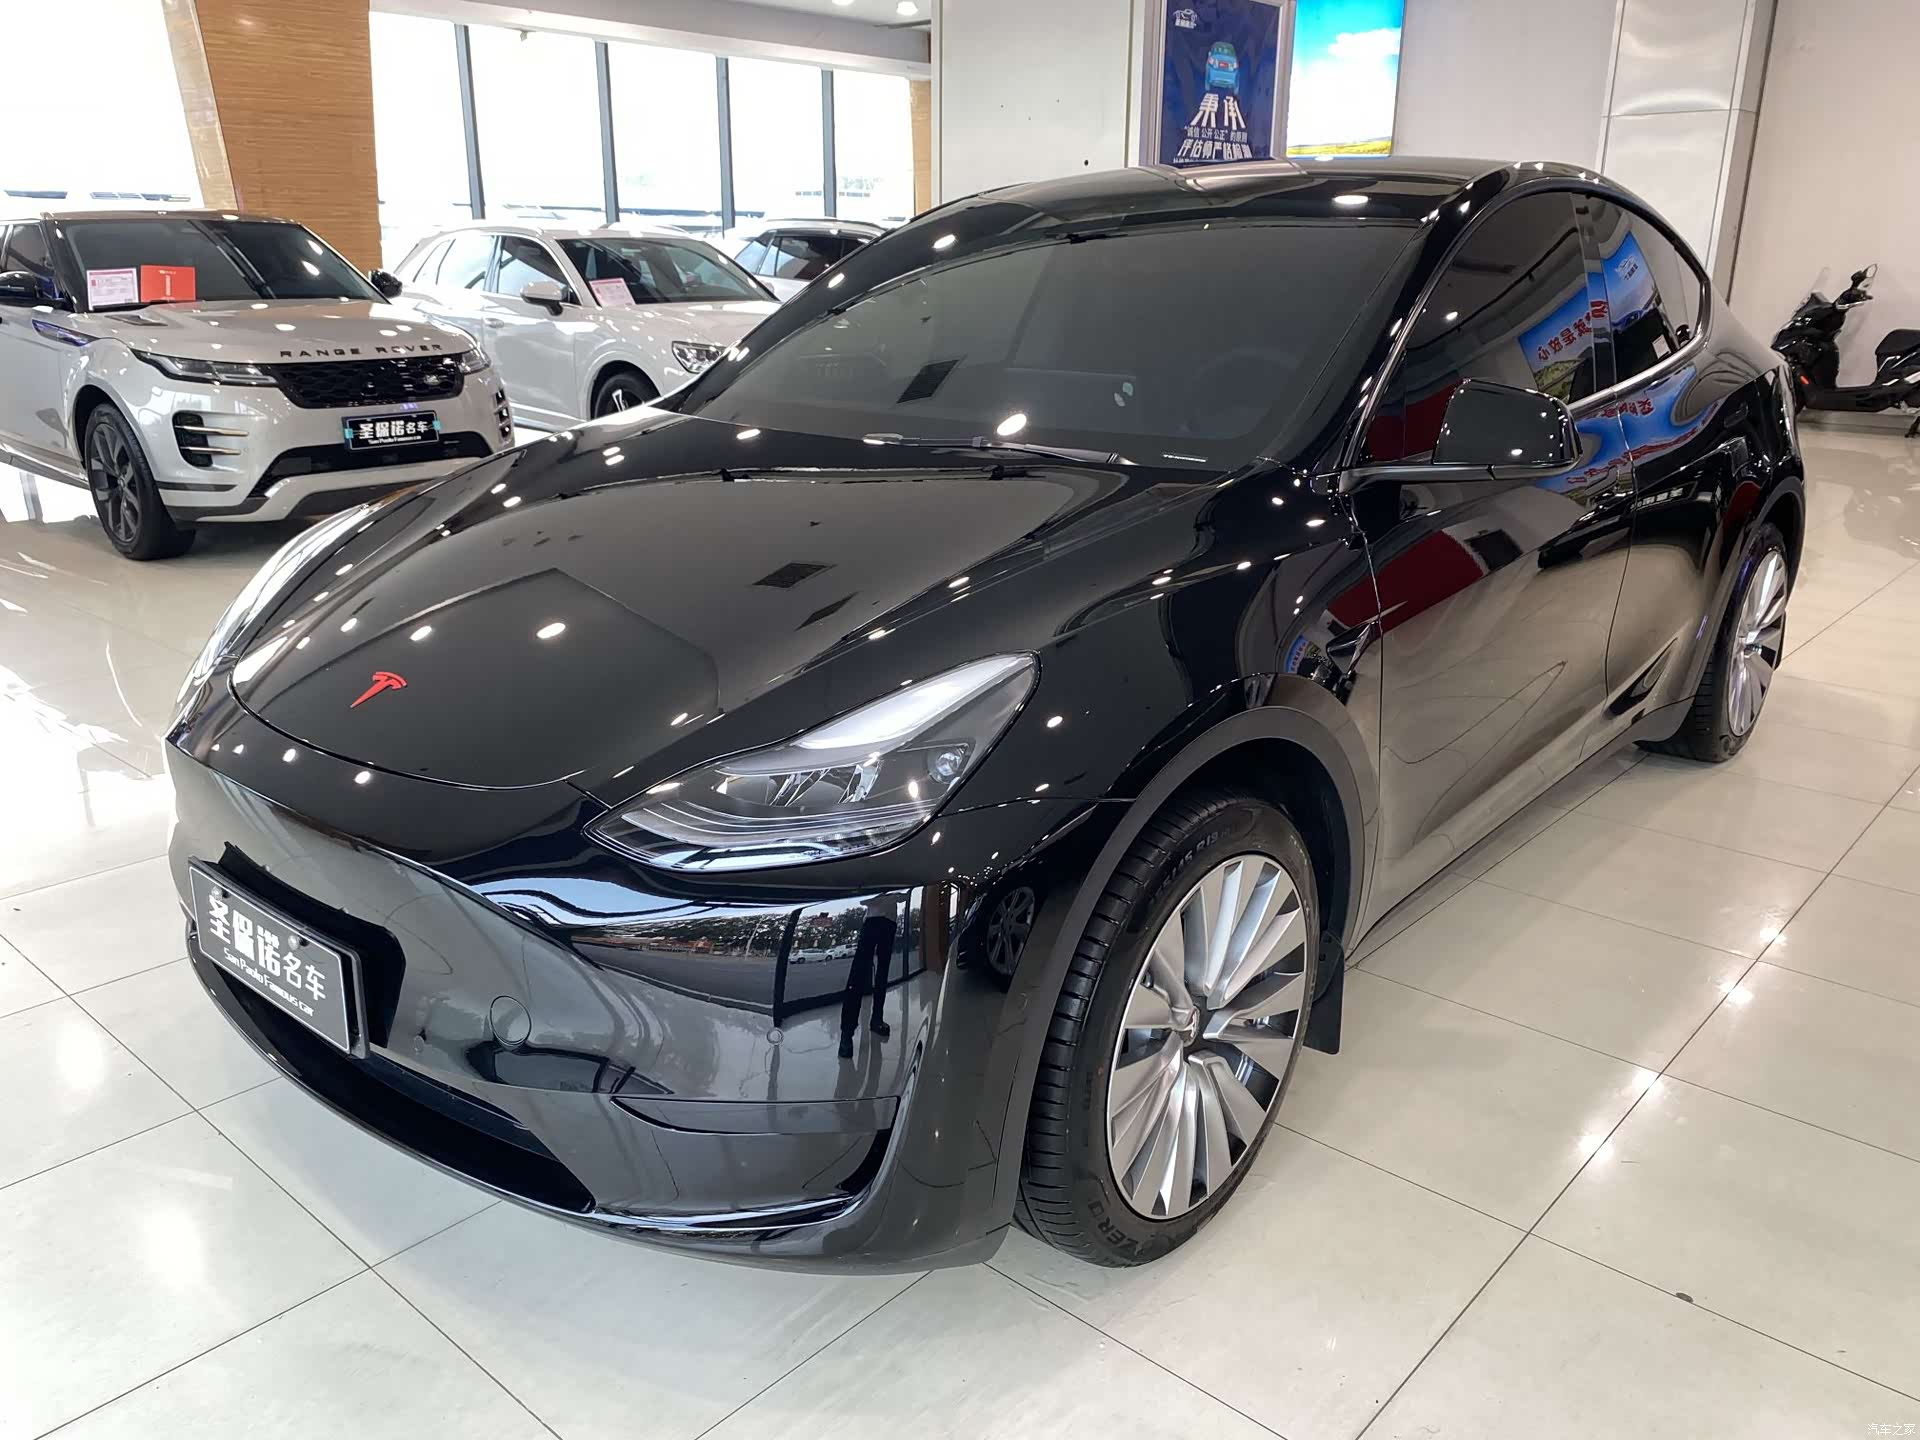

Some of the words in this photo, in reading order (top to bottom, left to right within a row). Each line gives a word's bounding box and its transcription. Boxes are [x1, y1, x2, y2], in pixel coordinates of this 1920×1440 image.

[1190, 92, 1246, 130] 秉承
[280, 348, 361, 358] RANGE
[376, 344, 443, 354] ROVER
[359, 420, 428, 440] 圣保诺名车
[208, 894, 327, 1001] 圣保诺名车
[223, 947, 241, 967] San
[239, 957, 264, 984] Paolo
[263, 974, 299, 1007] Famous
